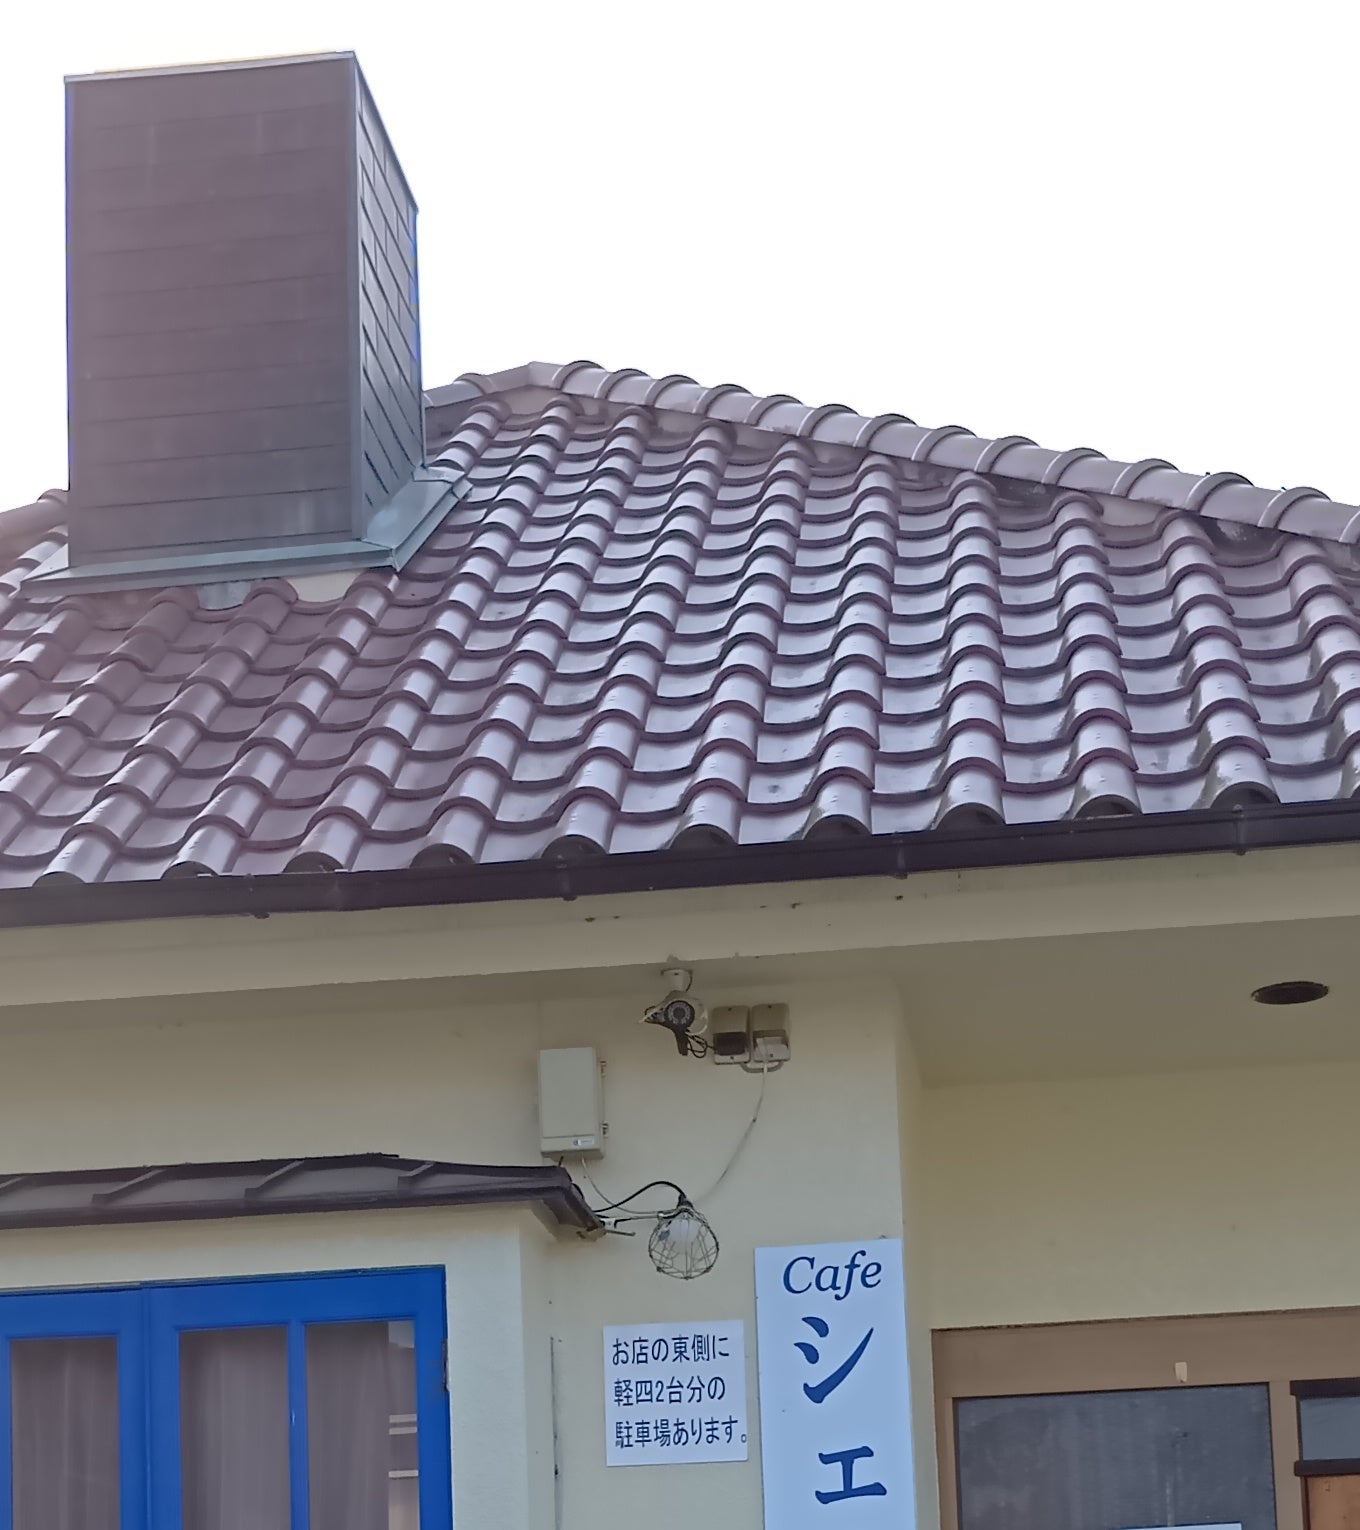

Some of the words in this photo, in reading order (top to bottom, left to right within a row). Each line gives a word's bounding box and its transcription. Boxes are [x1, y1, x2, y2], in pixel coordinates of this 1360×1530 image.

[782, 1250, 883, 1301] Cafe
[612, 1333, 730, 1365] お店の東側に
[614, 1375, 726, 1407] 軽四2台分の
[615, 1415, 748, 1449] 駐車場あります。
